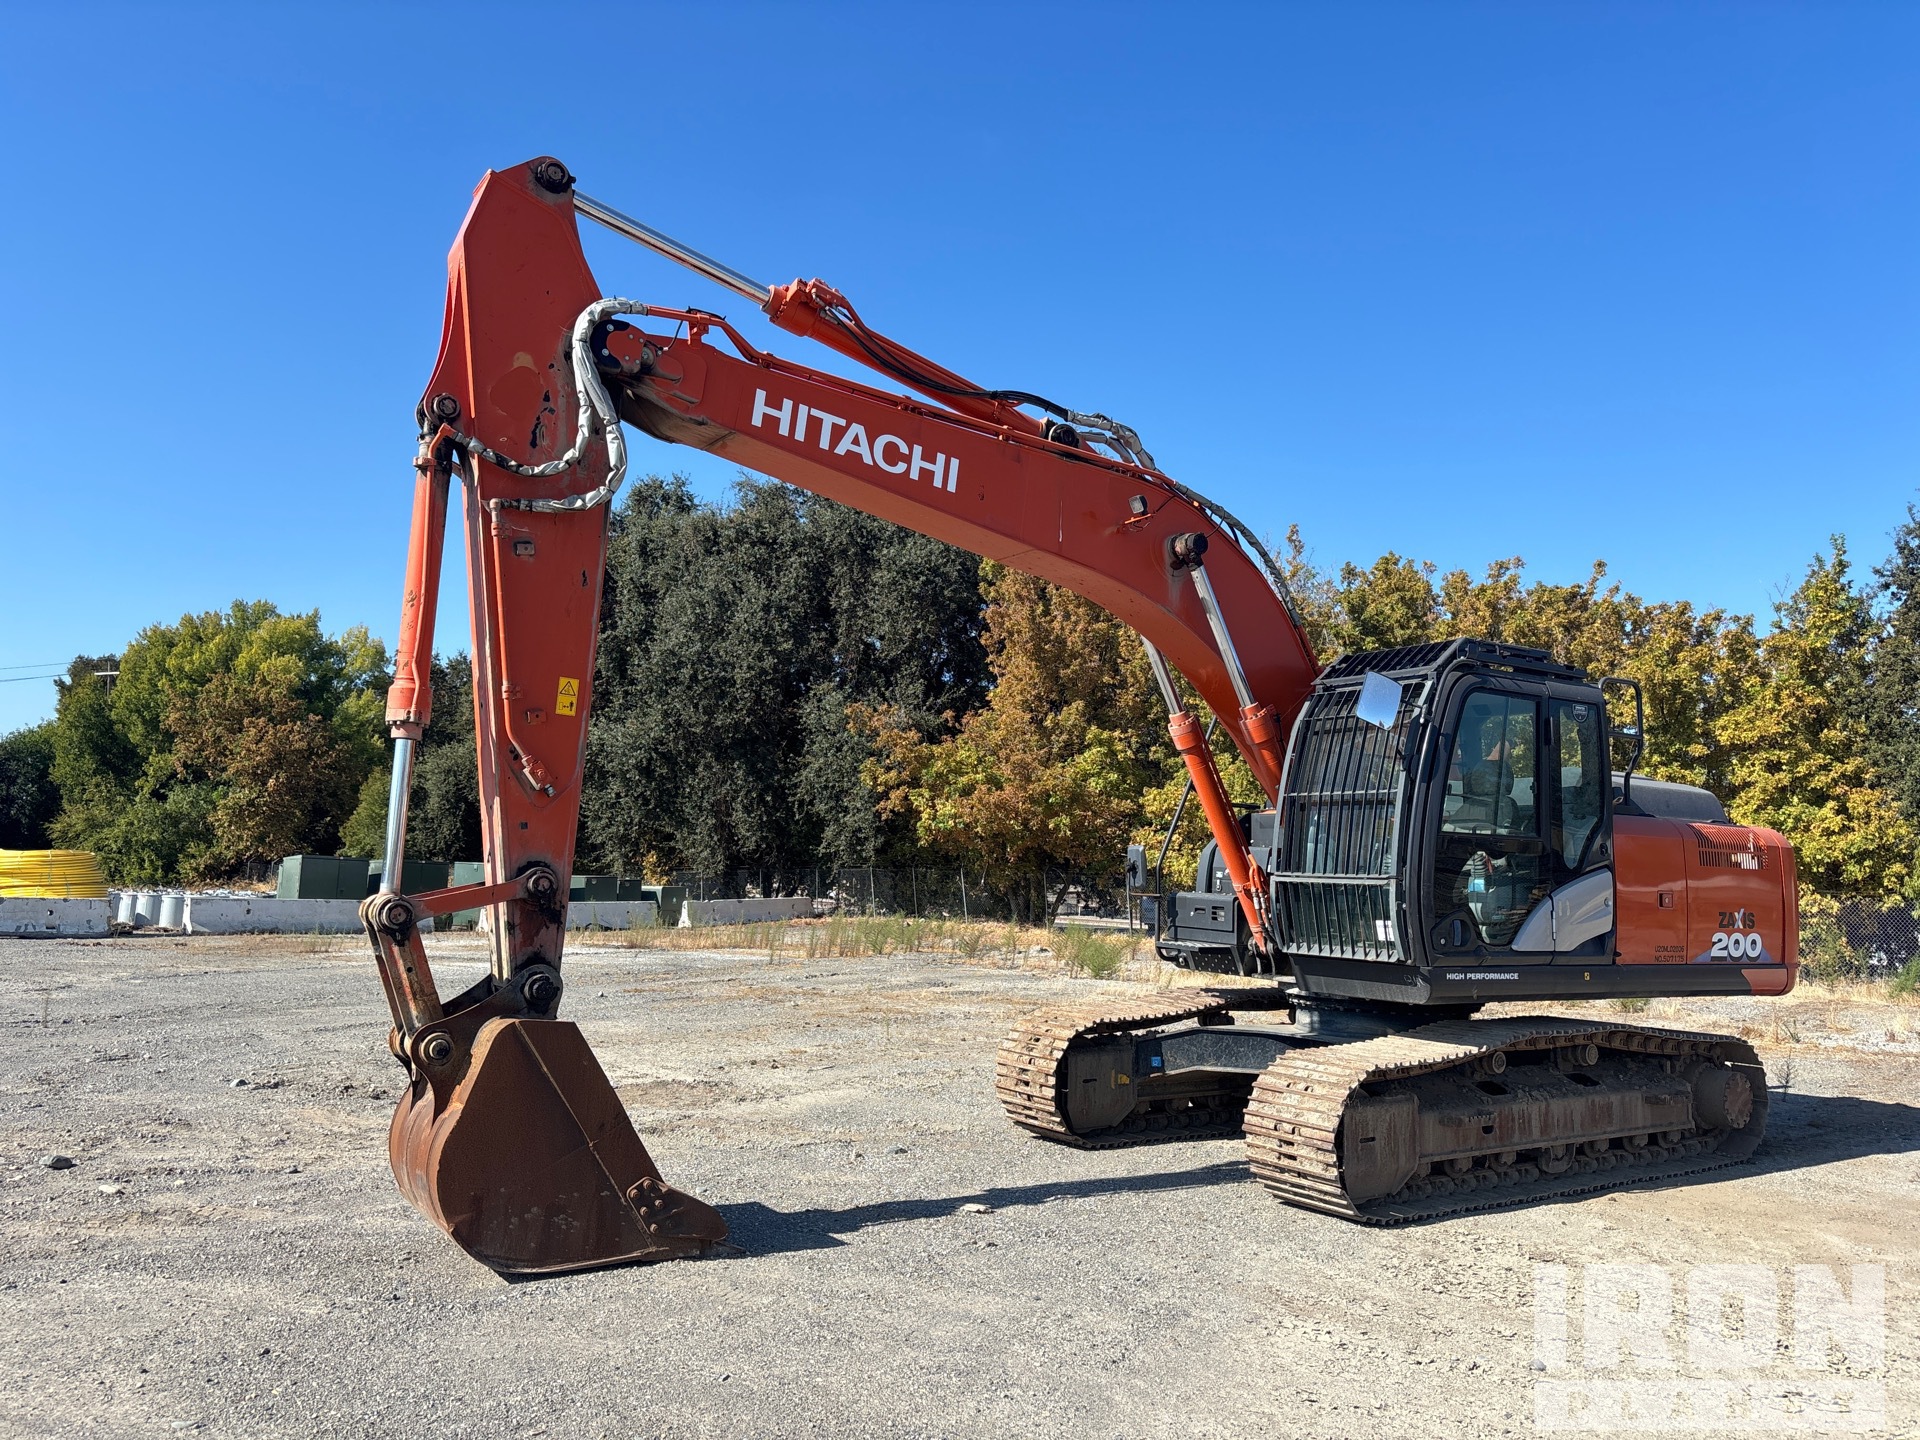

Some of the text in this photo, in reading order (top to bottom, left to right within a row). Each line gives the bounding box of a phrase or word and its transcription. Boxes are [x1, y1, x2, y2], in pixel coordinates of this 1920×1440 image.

[751, 388, 960, 493] HITACHI
[1718, 908, 1756, 929] ZAXIS
[1711, 932, 1762, 962] 200
[1446, 972, 1519, 980] HIGH PERFORMANCE
